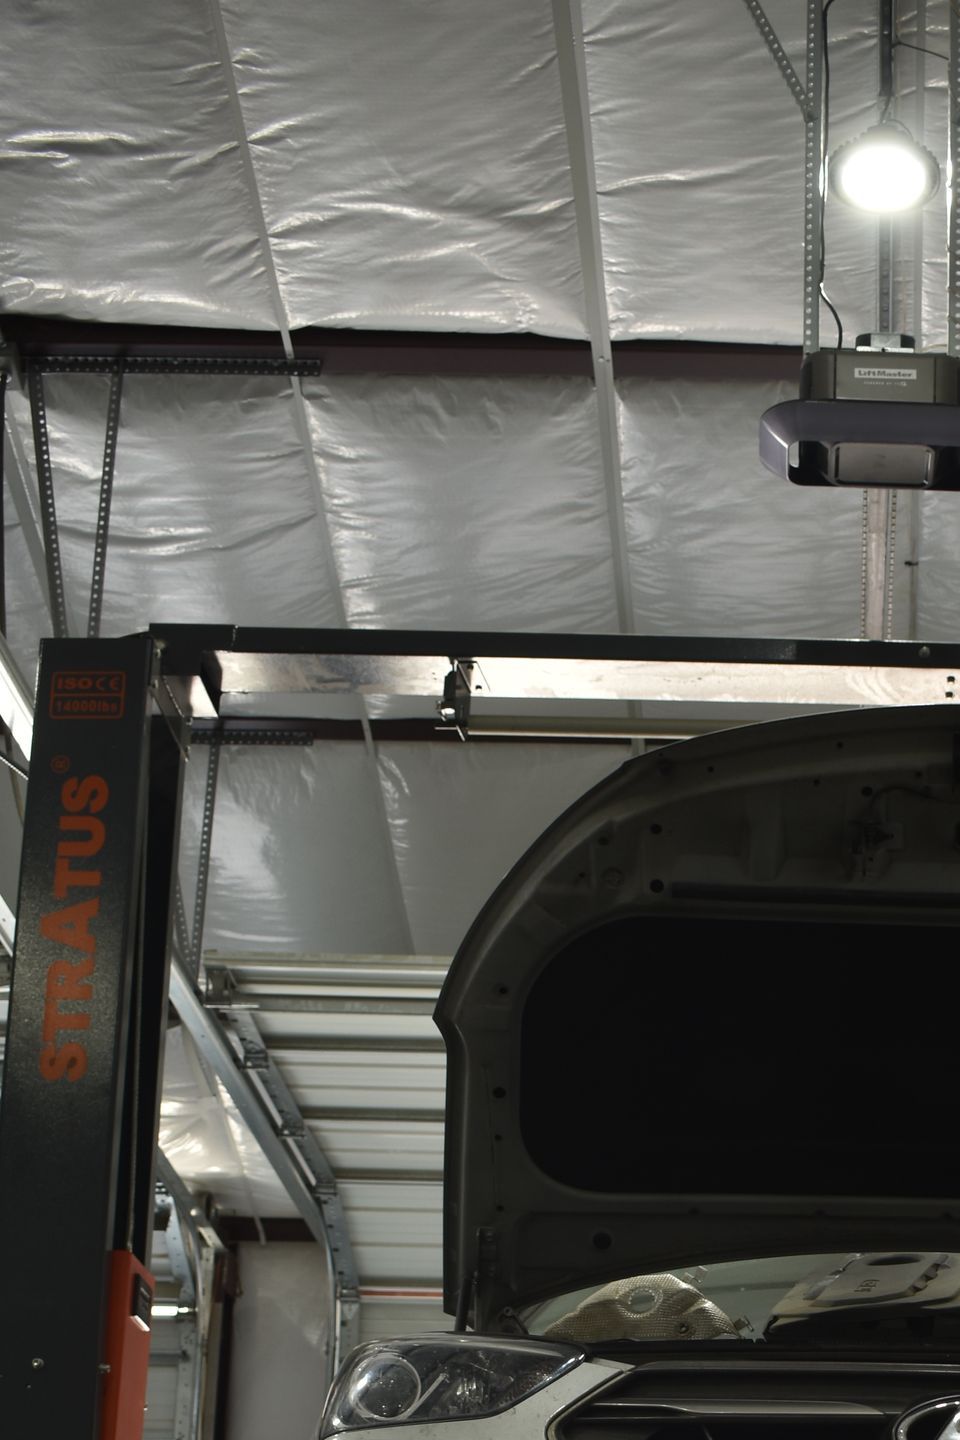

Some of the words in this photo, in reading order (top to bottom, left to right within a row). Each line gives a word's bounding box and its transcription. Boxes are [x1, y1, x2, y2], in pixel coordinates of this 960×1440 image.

[857, 369, 913, 378] LiftMaster
[56, 677, 93, 690] ISO
[39, 774, 110, 1083] STRATUS
